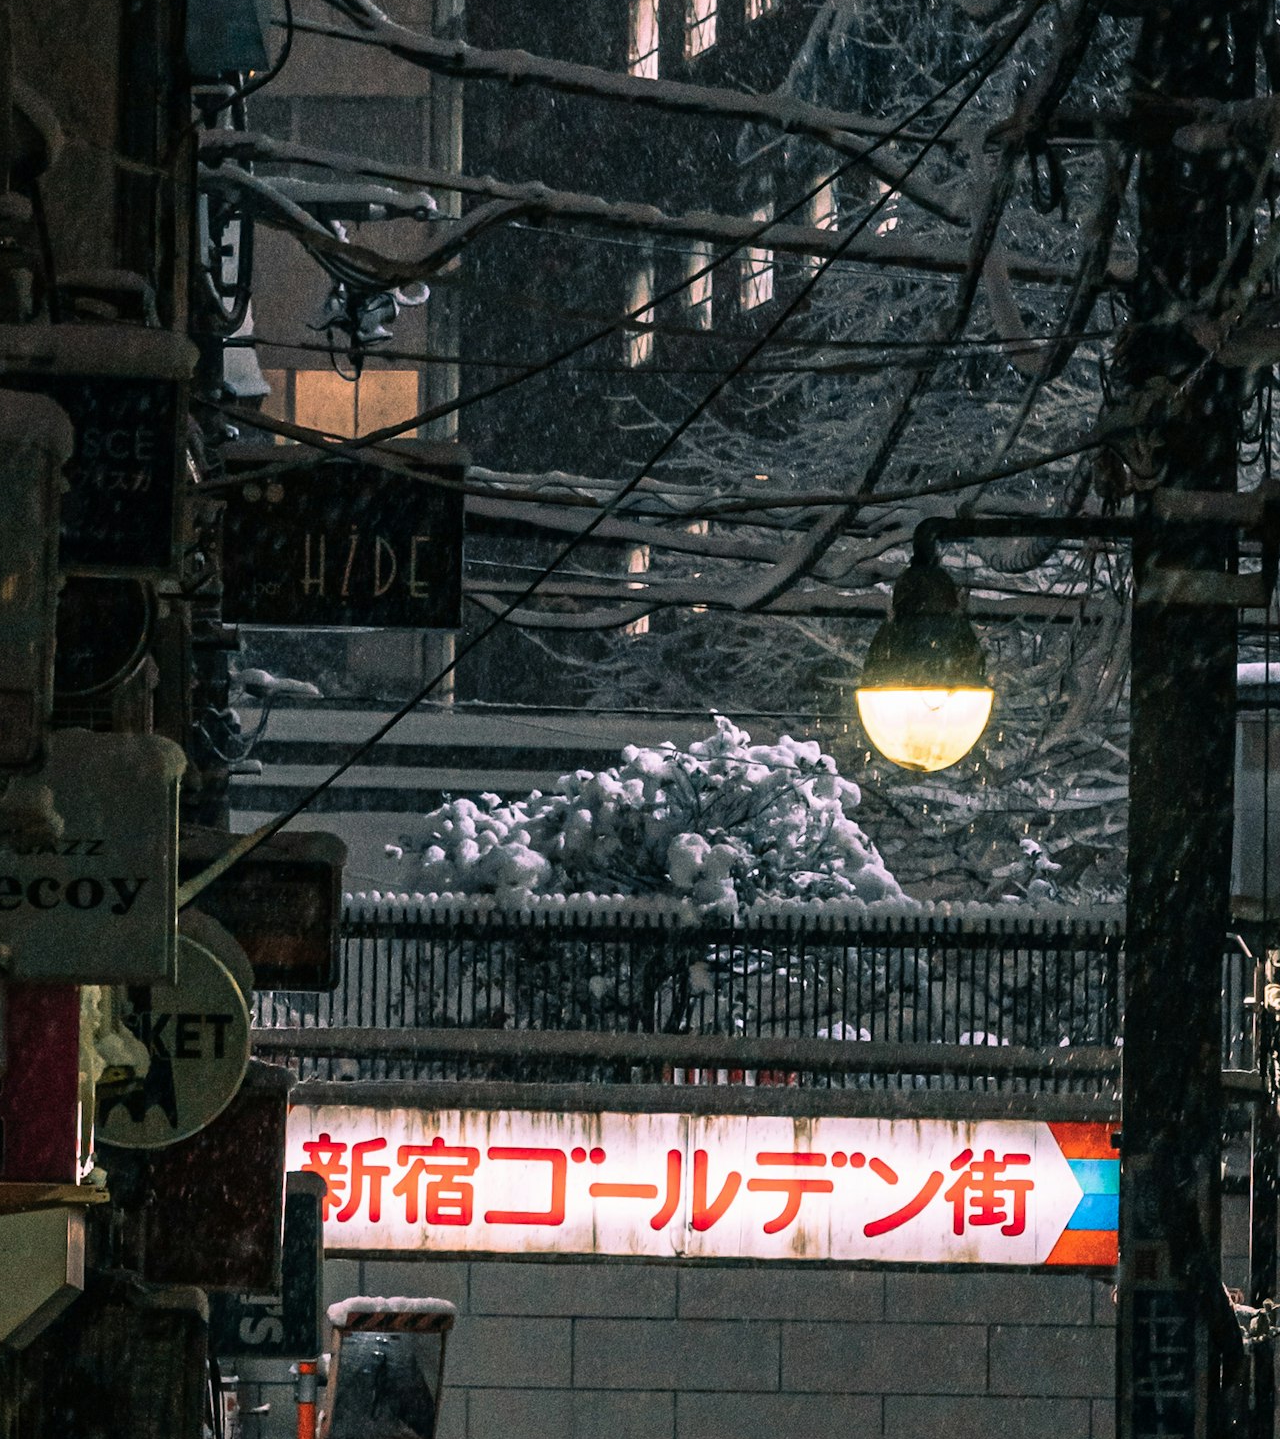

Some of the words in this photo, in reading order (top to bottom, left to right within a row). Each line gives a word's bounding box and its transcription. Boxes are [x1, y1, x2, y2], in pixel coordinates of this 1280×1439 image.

[302, 1133, 1037, 1239] 新宿ゴールデン街
